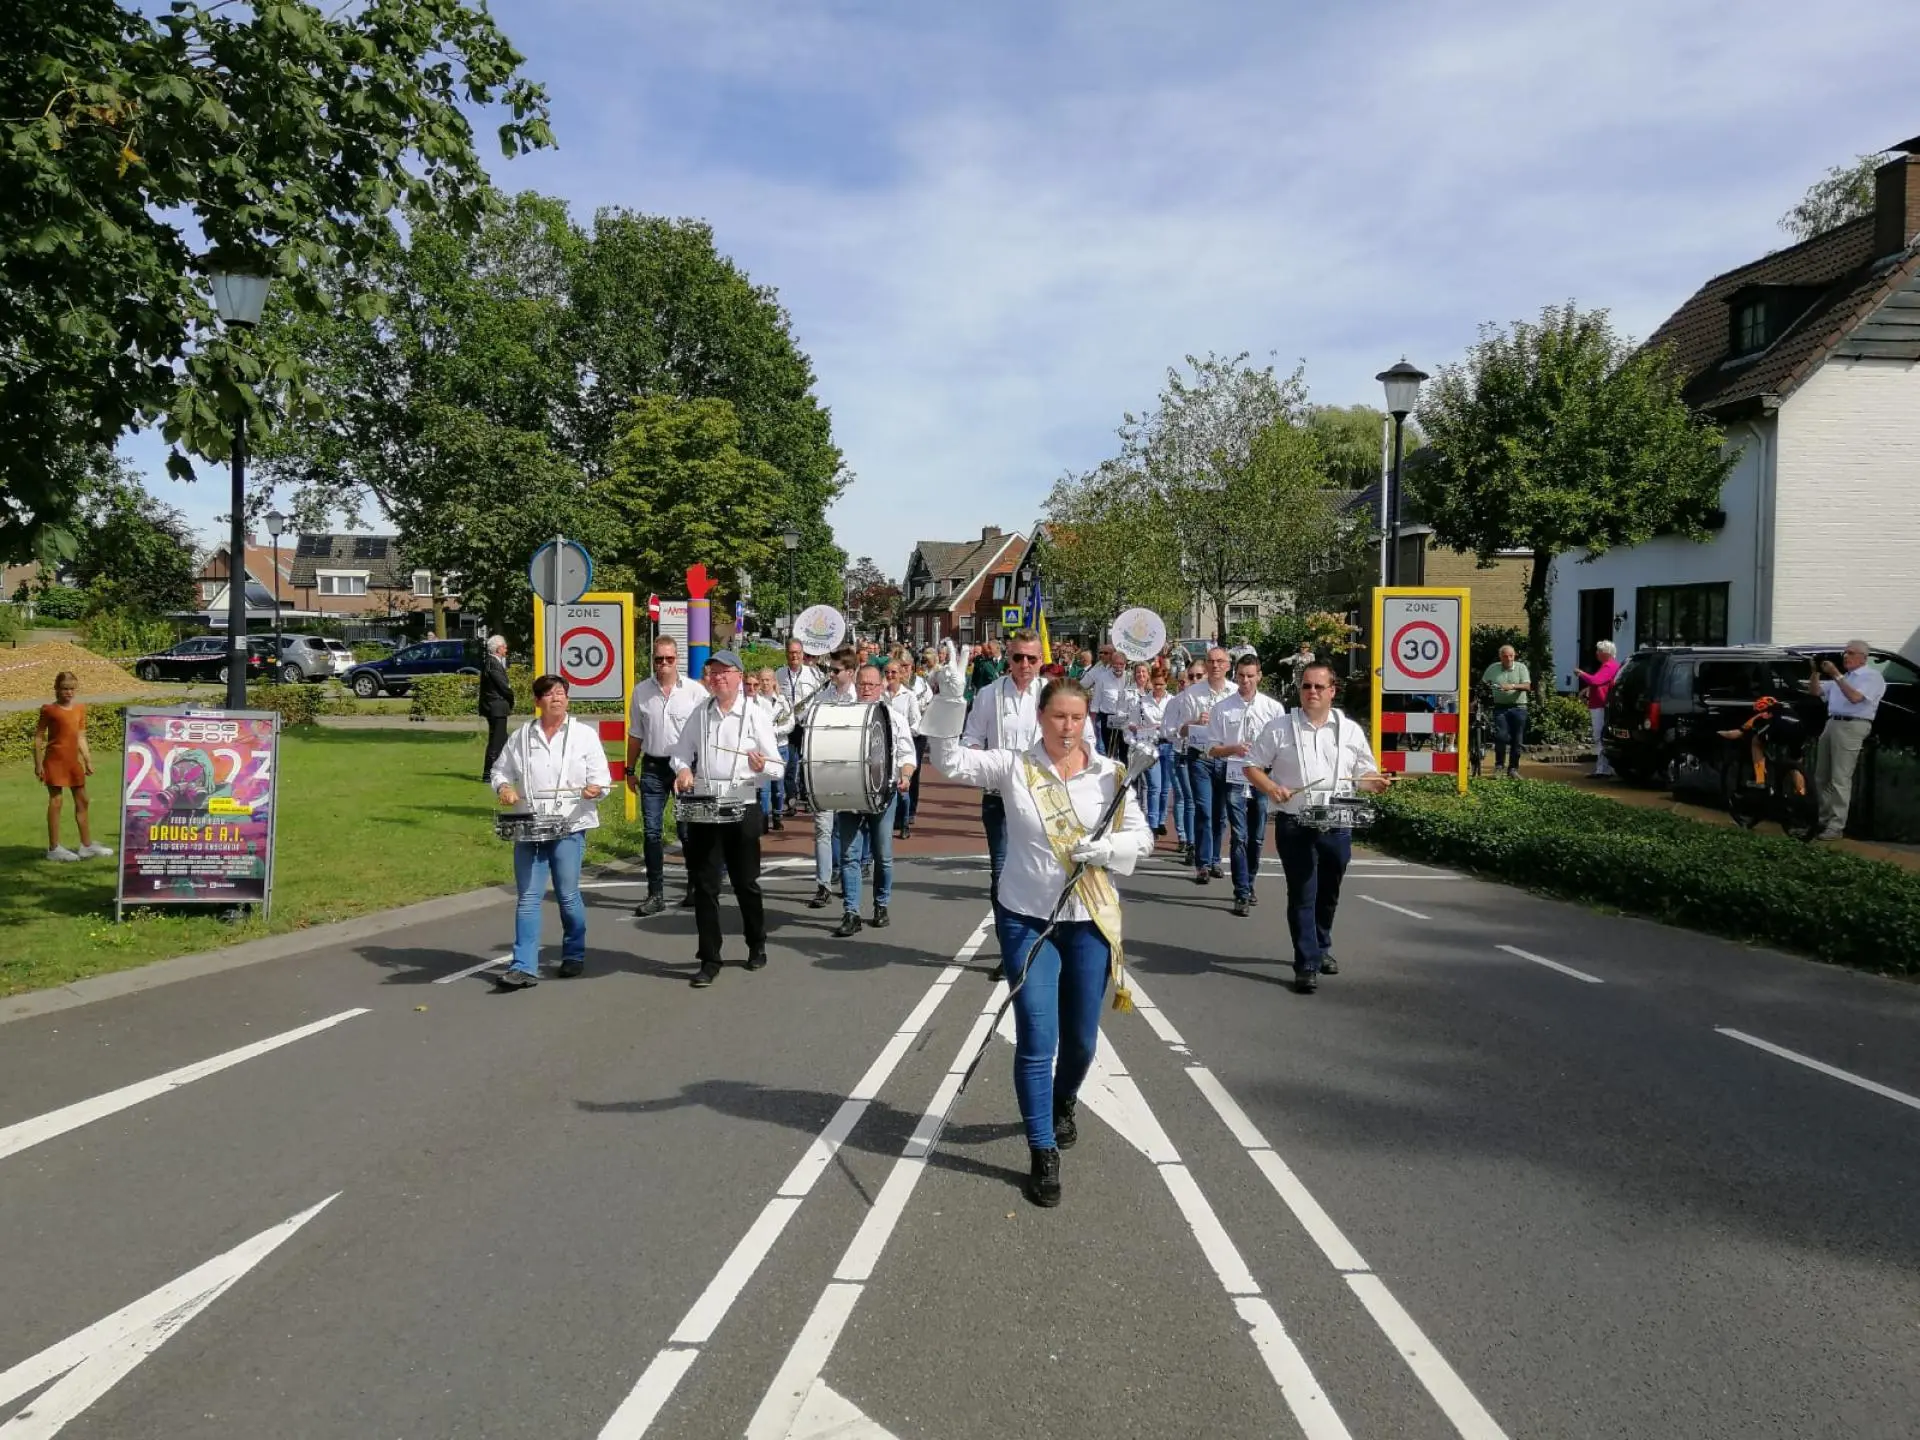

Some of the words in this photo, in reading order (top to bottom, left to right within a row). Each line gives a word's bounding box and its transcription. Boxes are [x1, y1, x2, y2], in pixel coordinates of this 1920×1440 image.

[567, 608, 601, 618] ZONE
[1405, 603, 1437, 612] ZONE
[568, 646, 603, 667] 30
[1403, 640, 1438, 660] 30
[149, 825, 198, 841] DRUGS
[219, 826, 244, 842] A.I.
